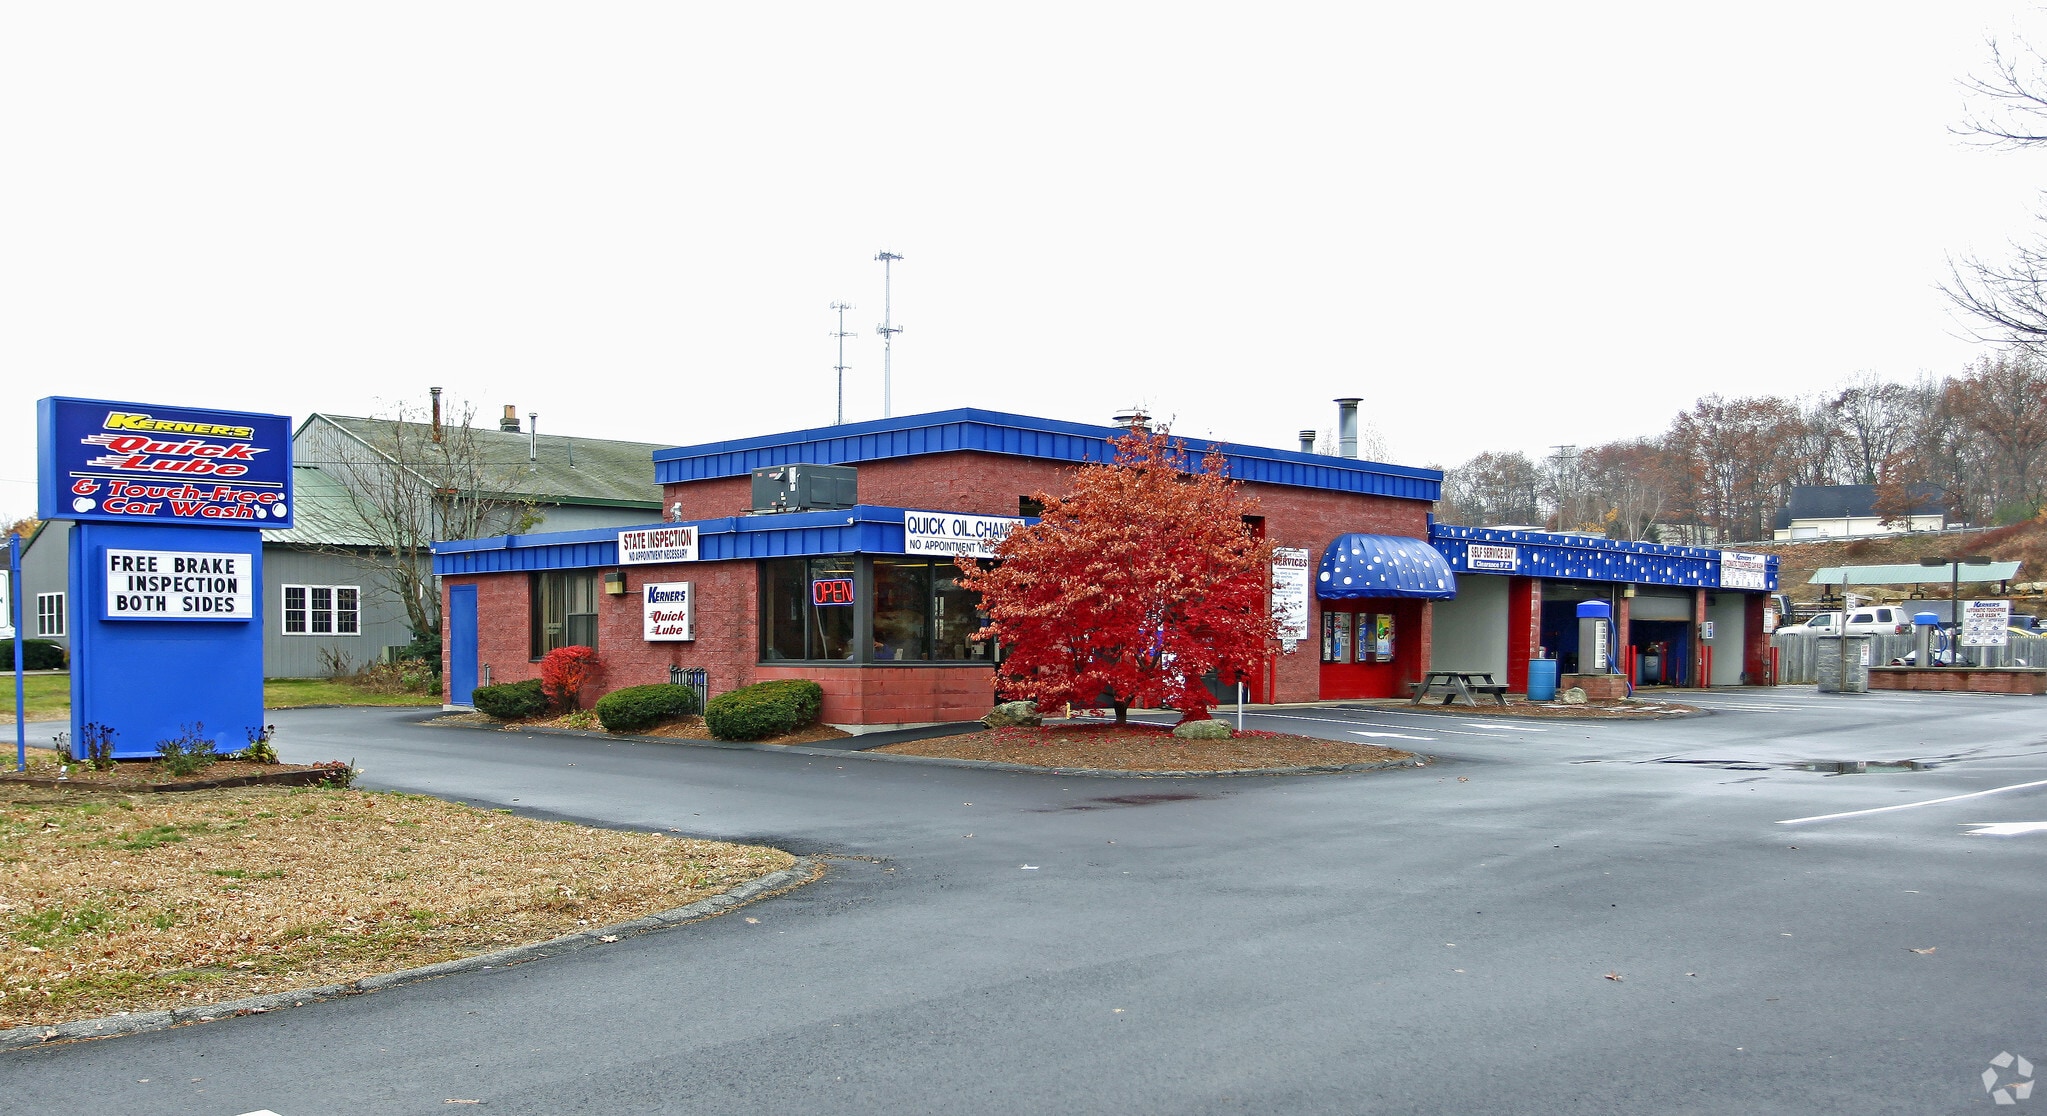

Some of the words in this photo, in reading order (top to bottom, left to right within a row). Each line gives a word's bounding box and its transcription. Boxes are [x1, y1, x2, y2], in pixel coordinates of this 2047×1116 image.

[106, 434, 262, 461] Quick
[118, 454, 249, 477] Lube
[72, 479, 101, 496] &
[108, 480, 279, 504] Touch-Free
[102, 497, 161, 516] Car
[171, 500, 254, 519] Wash
[907, 516, 946, 535] QUICK
[952, 519, 971, 537] OIL
[624, 532, 646, 551] STATE
[647, 529, 692, 549] INSPECTION
[910, 540, 921, 550] NO
[925, 540, 976, 553] APPOINTMENT
[629, 551, 635, 561] NO
[635, 549, 663, 561] APPOINTMENT
[664, 548, 688, 560] NECESSARY
[1471, 546, 1482, 558] SELF
[1484, 547, 1503, 559] SERVICE
[1504, 548, 1513, 559] BAY
[111, 555, 158, 573] FREE
[174, 557, 235, 574] BRAKE
[128, 576, 237, 593] INSPECTION
[814, 581, 854, 603] OPEN
[117, 595, 166, 611] BOTH
[183, 597, 235, 612] SIDES
[653, 611, 685, 623] Quick
[655, 625, 682, 635] Lube
